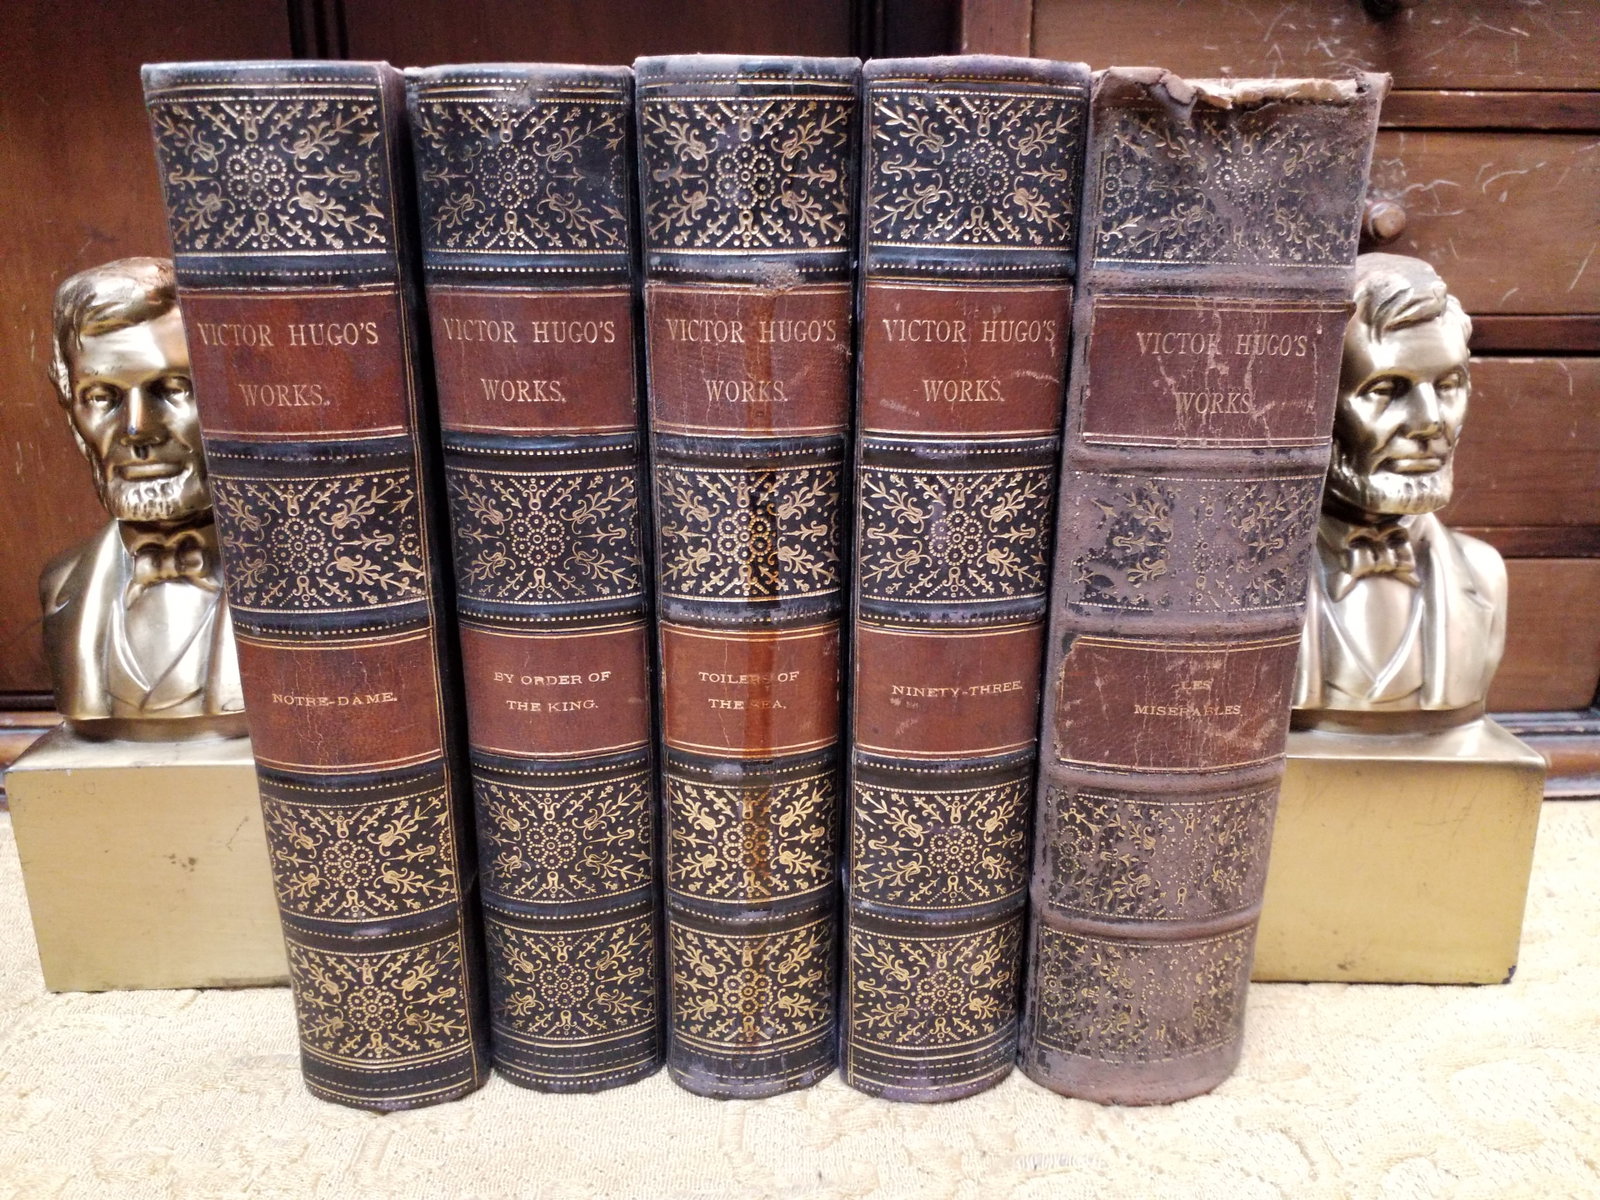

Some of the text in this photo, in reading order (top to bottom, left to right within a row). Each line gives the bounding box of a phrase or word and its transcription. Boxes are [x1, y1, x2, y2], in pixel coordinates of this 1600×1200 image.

[197, 322, 379, 347] VICTOR HUGO'S
[443, 318, 616, 344] VICTOR HUGO'S
[666, 318, 837, 343] VICTOR HUGO'S
[882, 318, 1056, 343] VICTOR HUGO'S
[1136, 332, 1308, 357] VICTOR HUGO'S
[494, 671, 611, 686] BY ORDER OF
[777, 671, 799, 683] OF
[1181, 680, 1212, 690] LES
[506, 700, 541, 712] THE
[708, 698, 744, 710] THE
